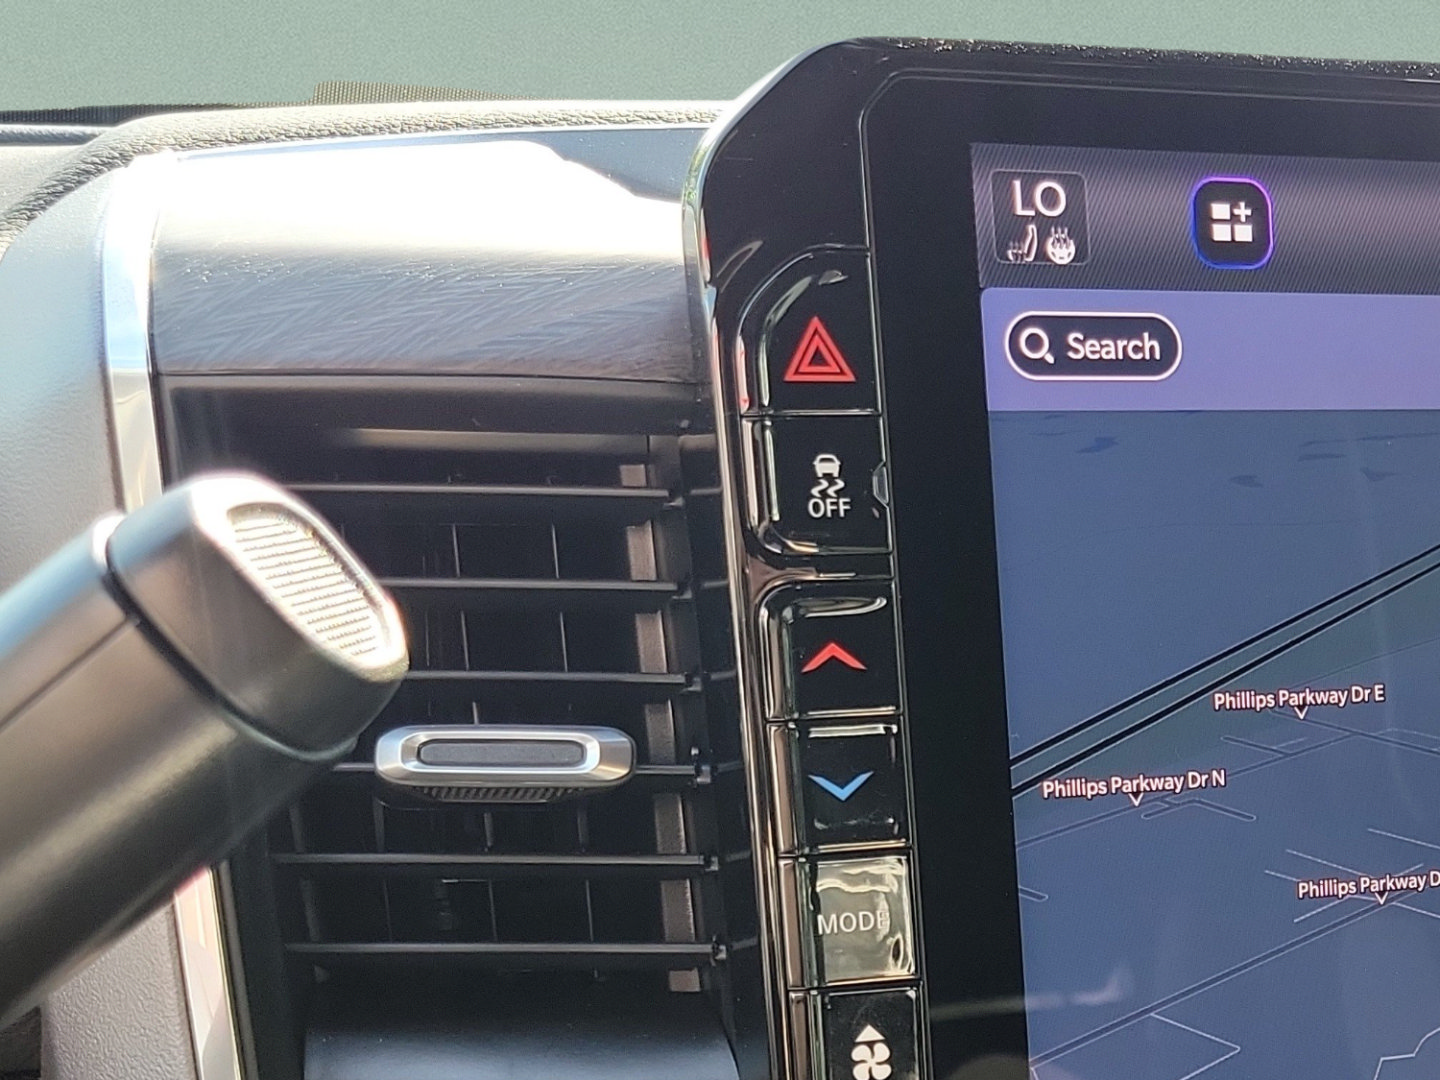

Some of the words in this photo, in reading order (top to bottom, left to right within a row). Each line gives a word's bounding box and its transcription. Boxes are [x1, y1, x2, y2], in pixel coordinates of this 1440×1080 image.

[1012, 179, 1067, 218] LO
[1066, 331, 1162, 361] Search
[807, 498, 851, 518] OFF
[1213, 690, 1276, 712] Phillips
[1278, 686, 1349, 708] Parkway
[1350, 685, 1373, 703] Dr
[1373, 684, 1386, 702] E
[1042, 779, 1108, 801] Phillips
[1110, 774, 1185, 795] Parkway
[1187, 771, 1210, 788] Dr
[1211, 769, 1226, 787] N
[1298, 879, 1358, 899] Phillips
[1359, 873, 1428, 893] Parkway
[817, 909, 890, 936] MODE
